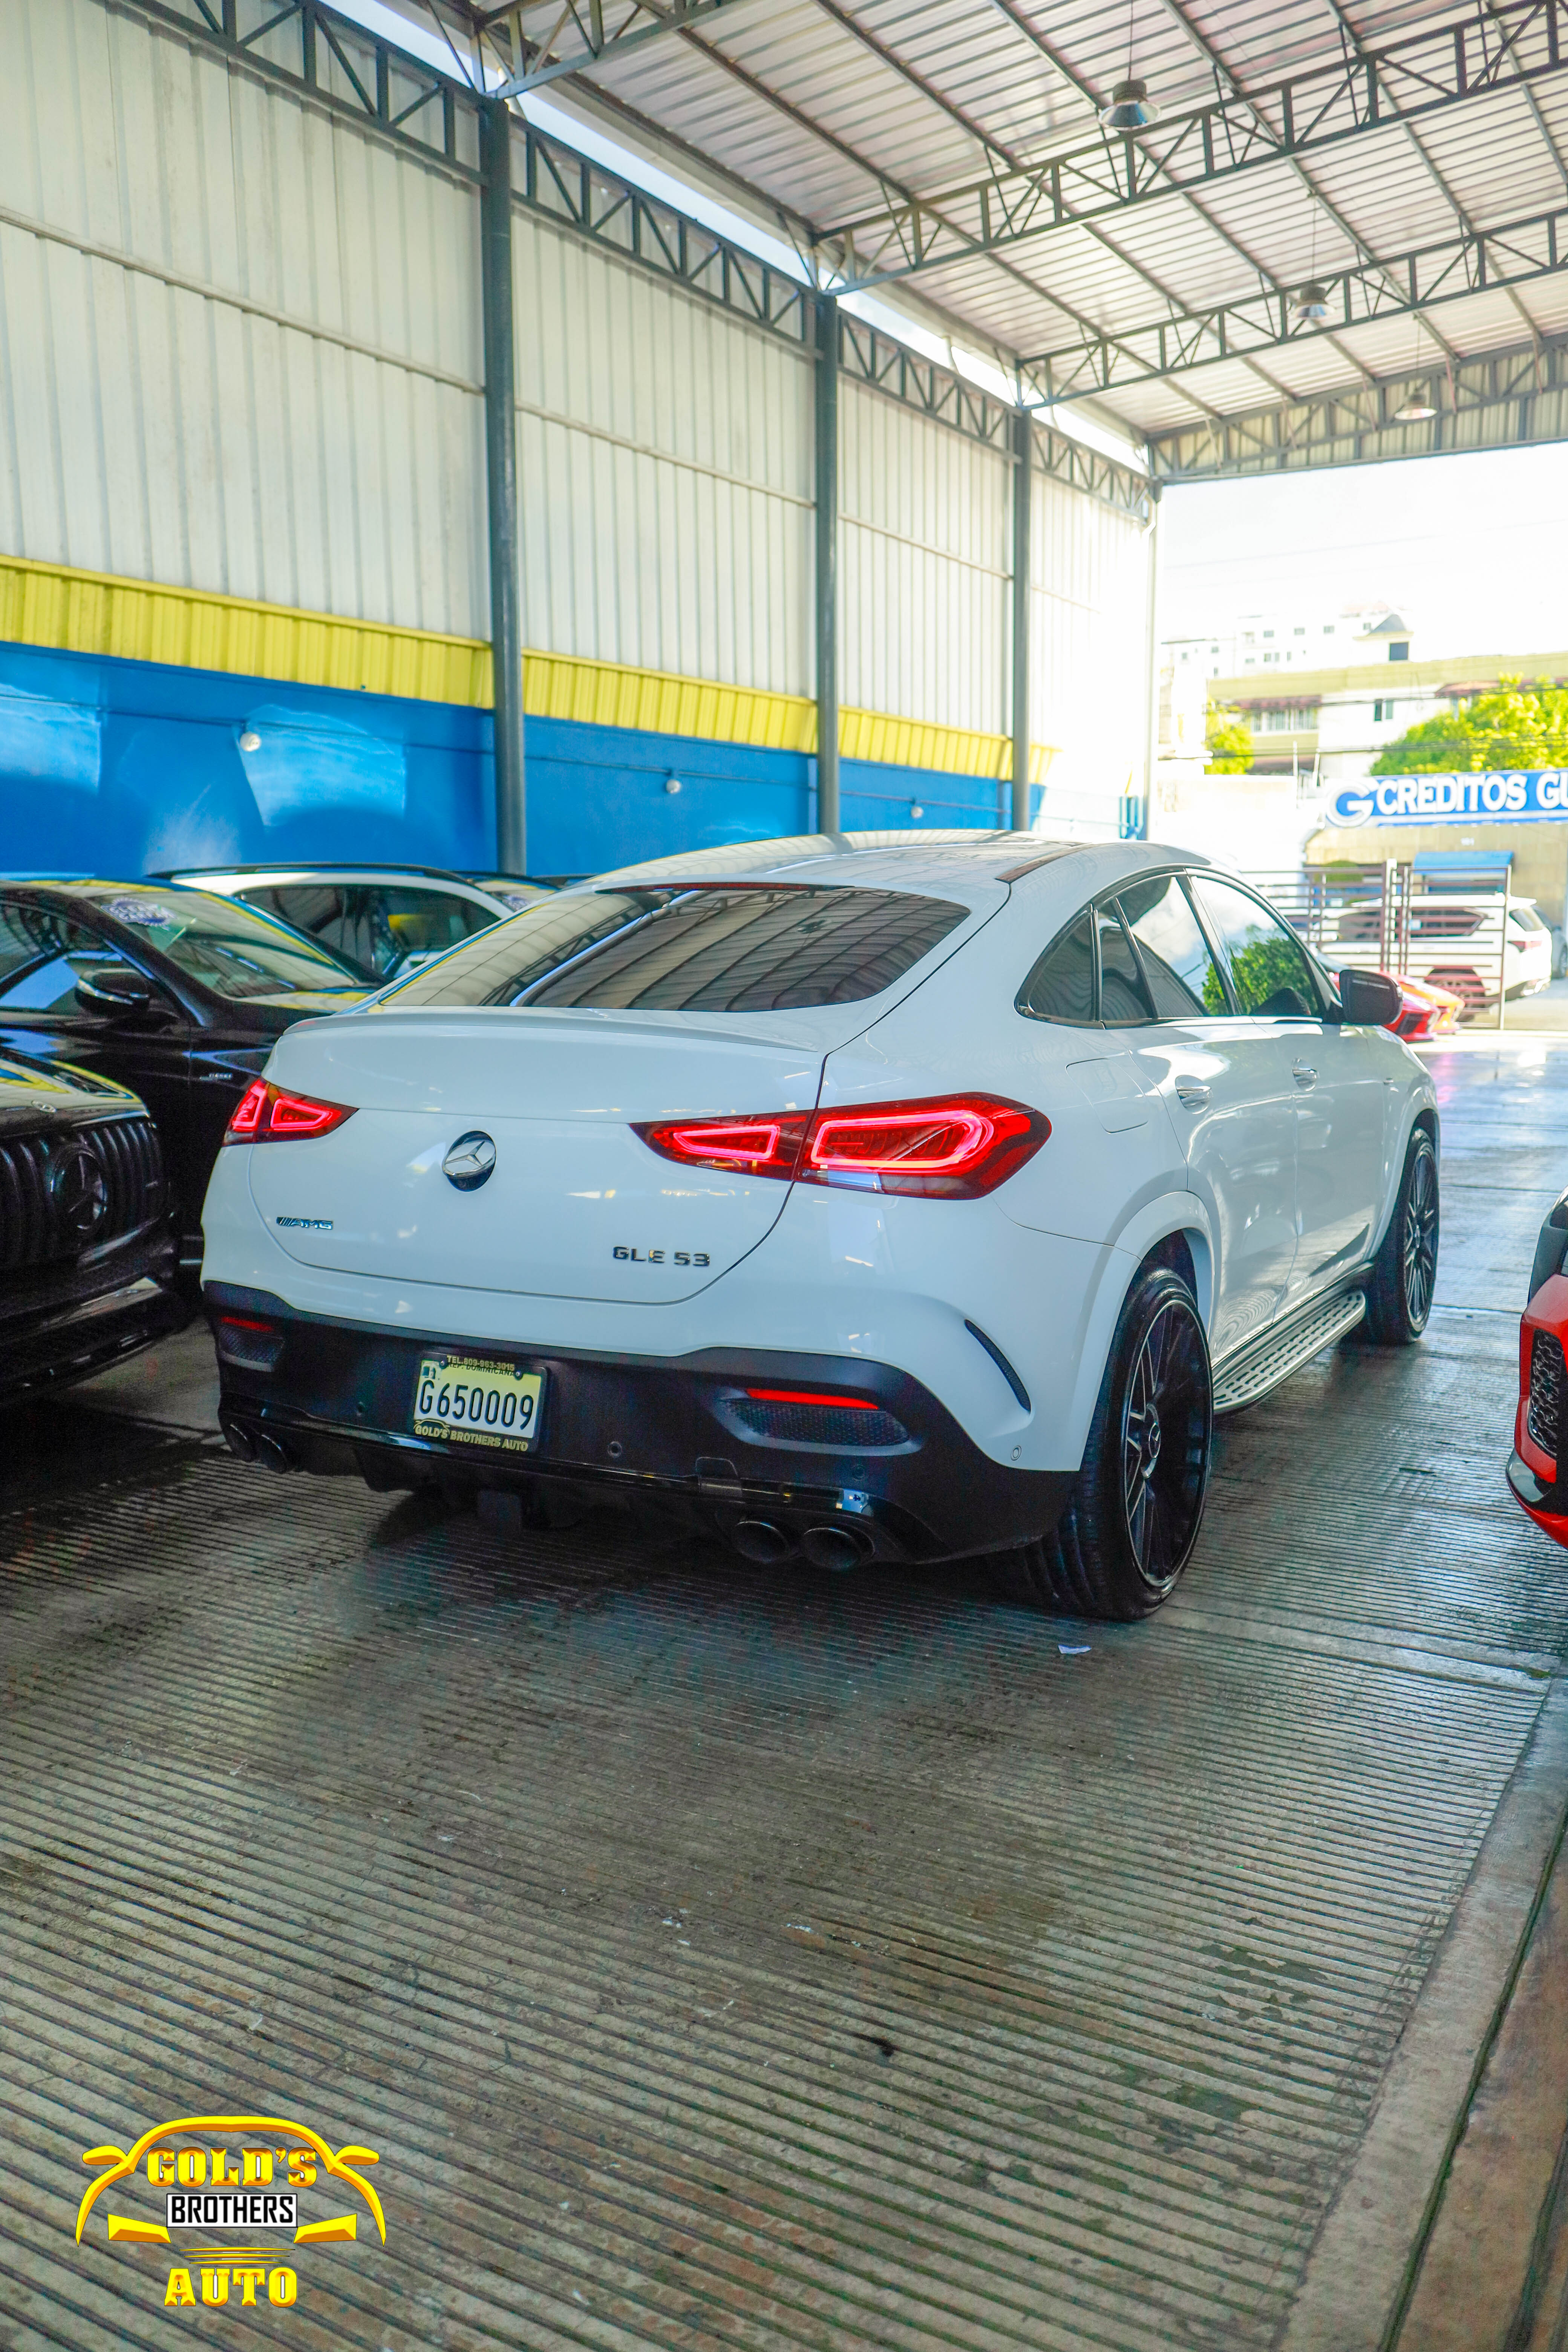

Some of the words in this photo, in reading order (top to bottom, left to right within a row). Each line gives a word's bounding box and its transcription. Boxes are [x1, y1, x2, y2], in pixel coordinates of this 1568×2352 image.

[1377, 773, 1527, 816] CREDITOS
[290, 1218, 333, 1230] AMG
[612, 1246, 666, 1263] GLE
[673, 1251, 710, 1267] 53
[419, 1380, 534, 1430] G650009
[415, 1425, 447, 1439] GOLD'S
[450, 1430, 501, 1447] BROTHERS
[502, 1439, 528, 1452] AUTO
